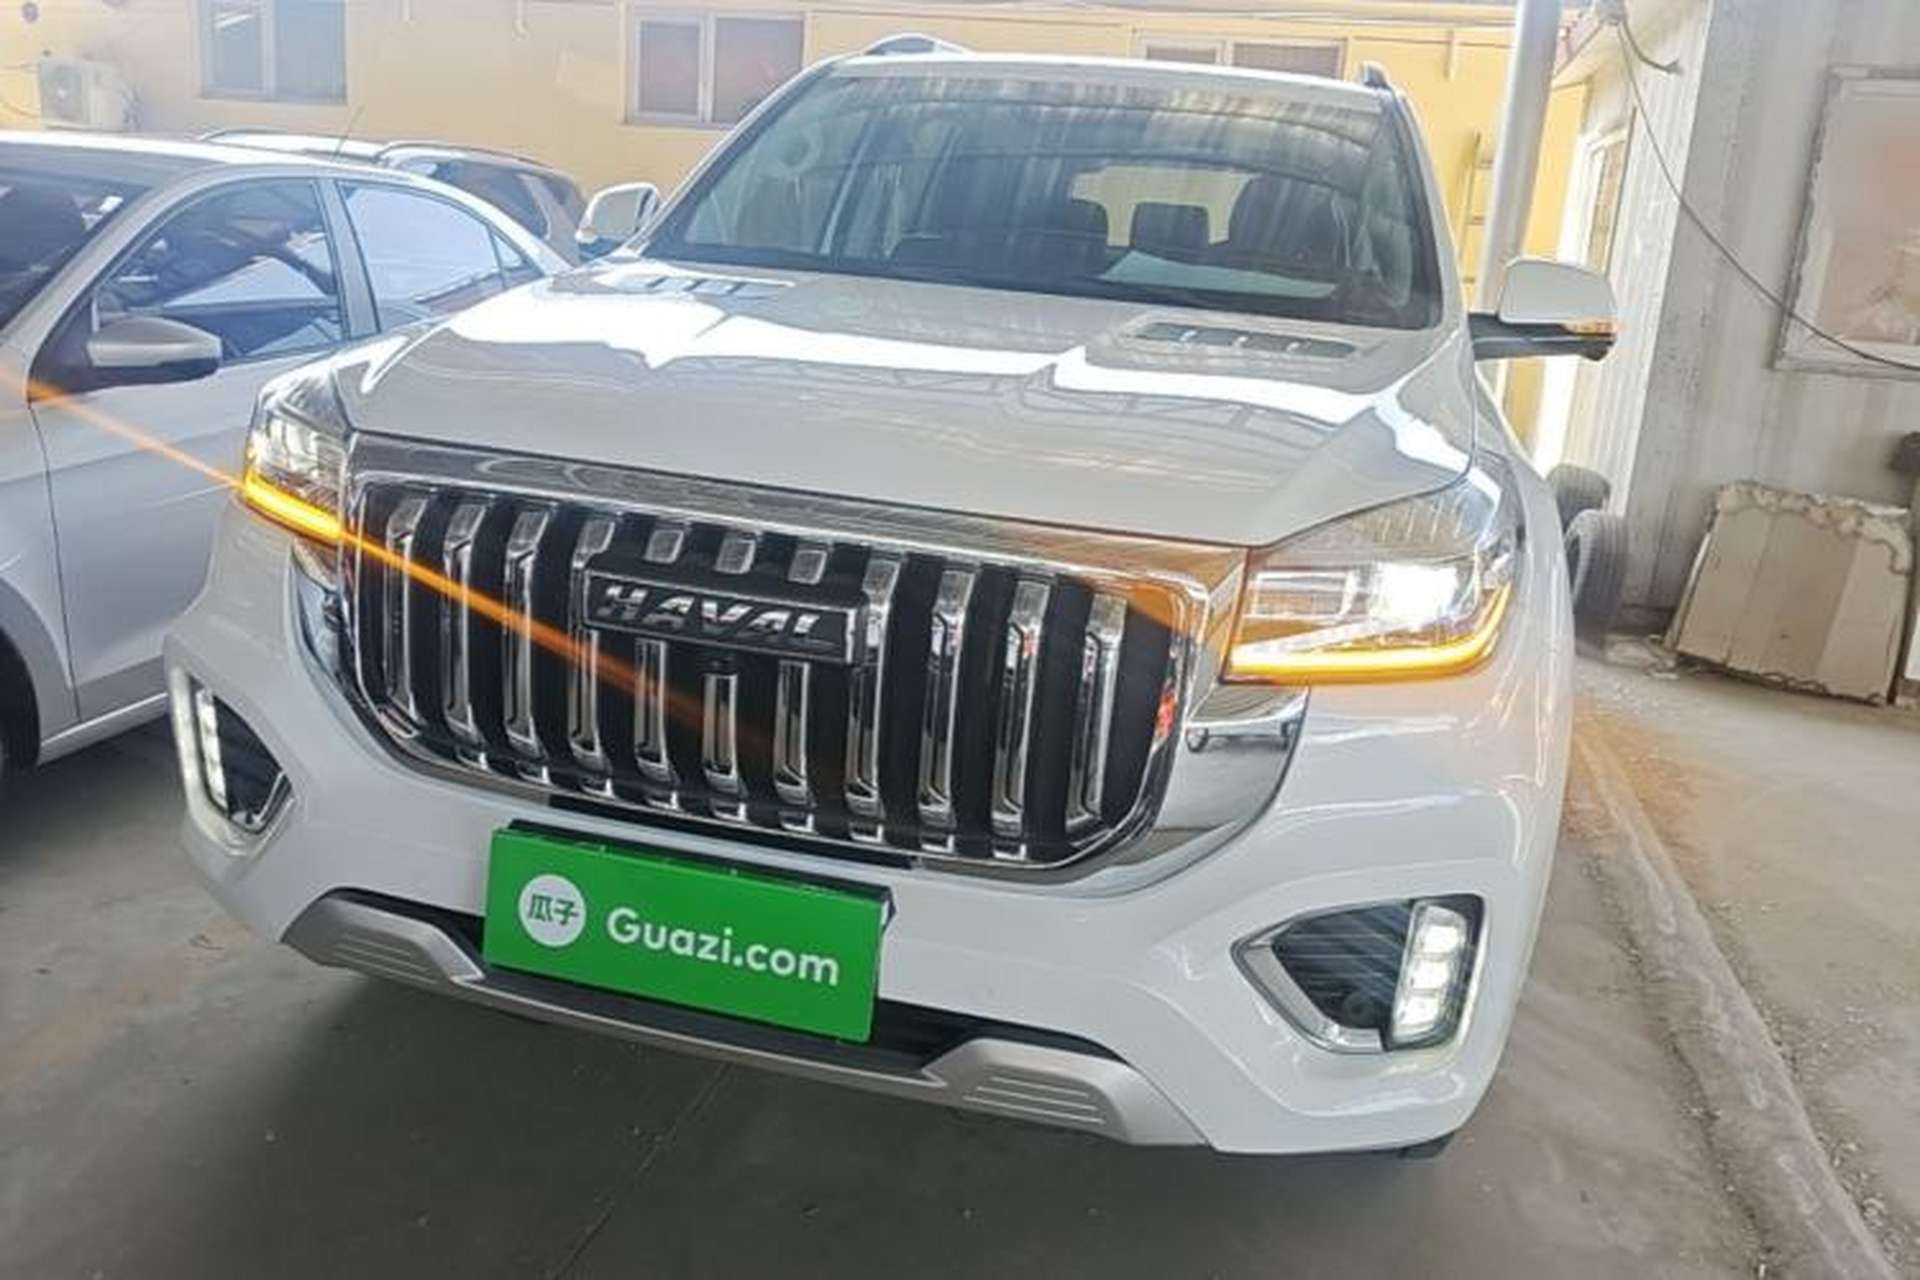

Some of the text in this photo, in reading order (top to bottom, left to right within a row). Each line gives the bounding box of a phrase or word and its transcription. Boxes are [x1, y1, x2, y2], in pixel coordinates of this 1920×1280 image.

[596, 584, 836, 649] HAVAL
[528, 892, 579, 927] 瓜子
[606, 906, 840, 987] Guazi.com
